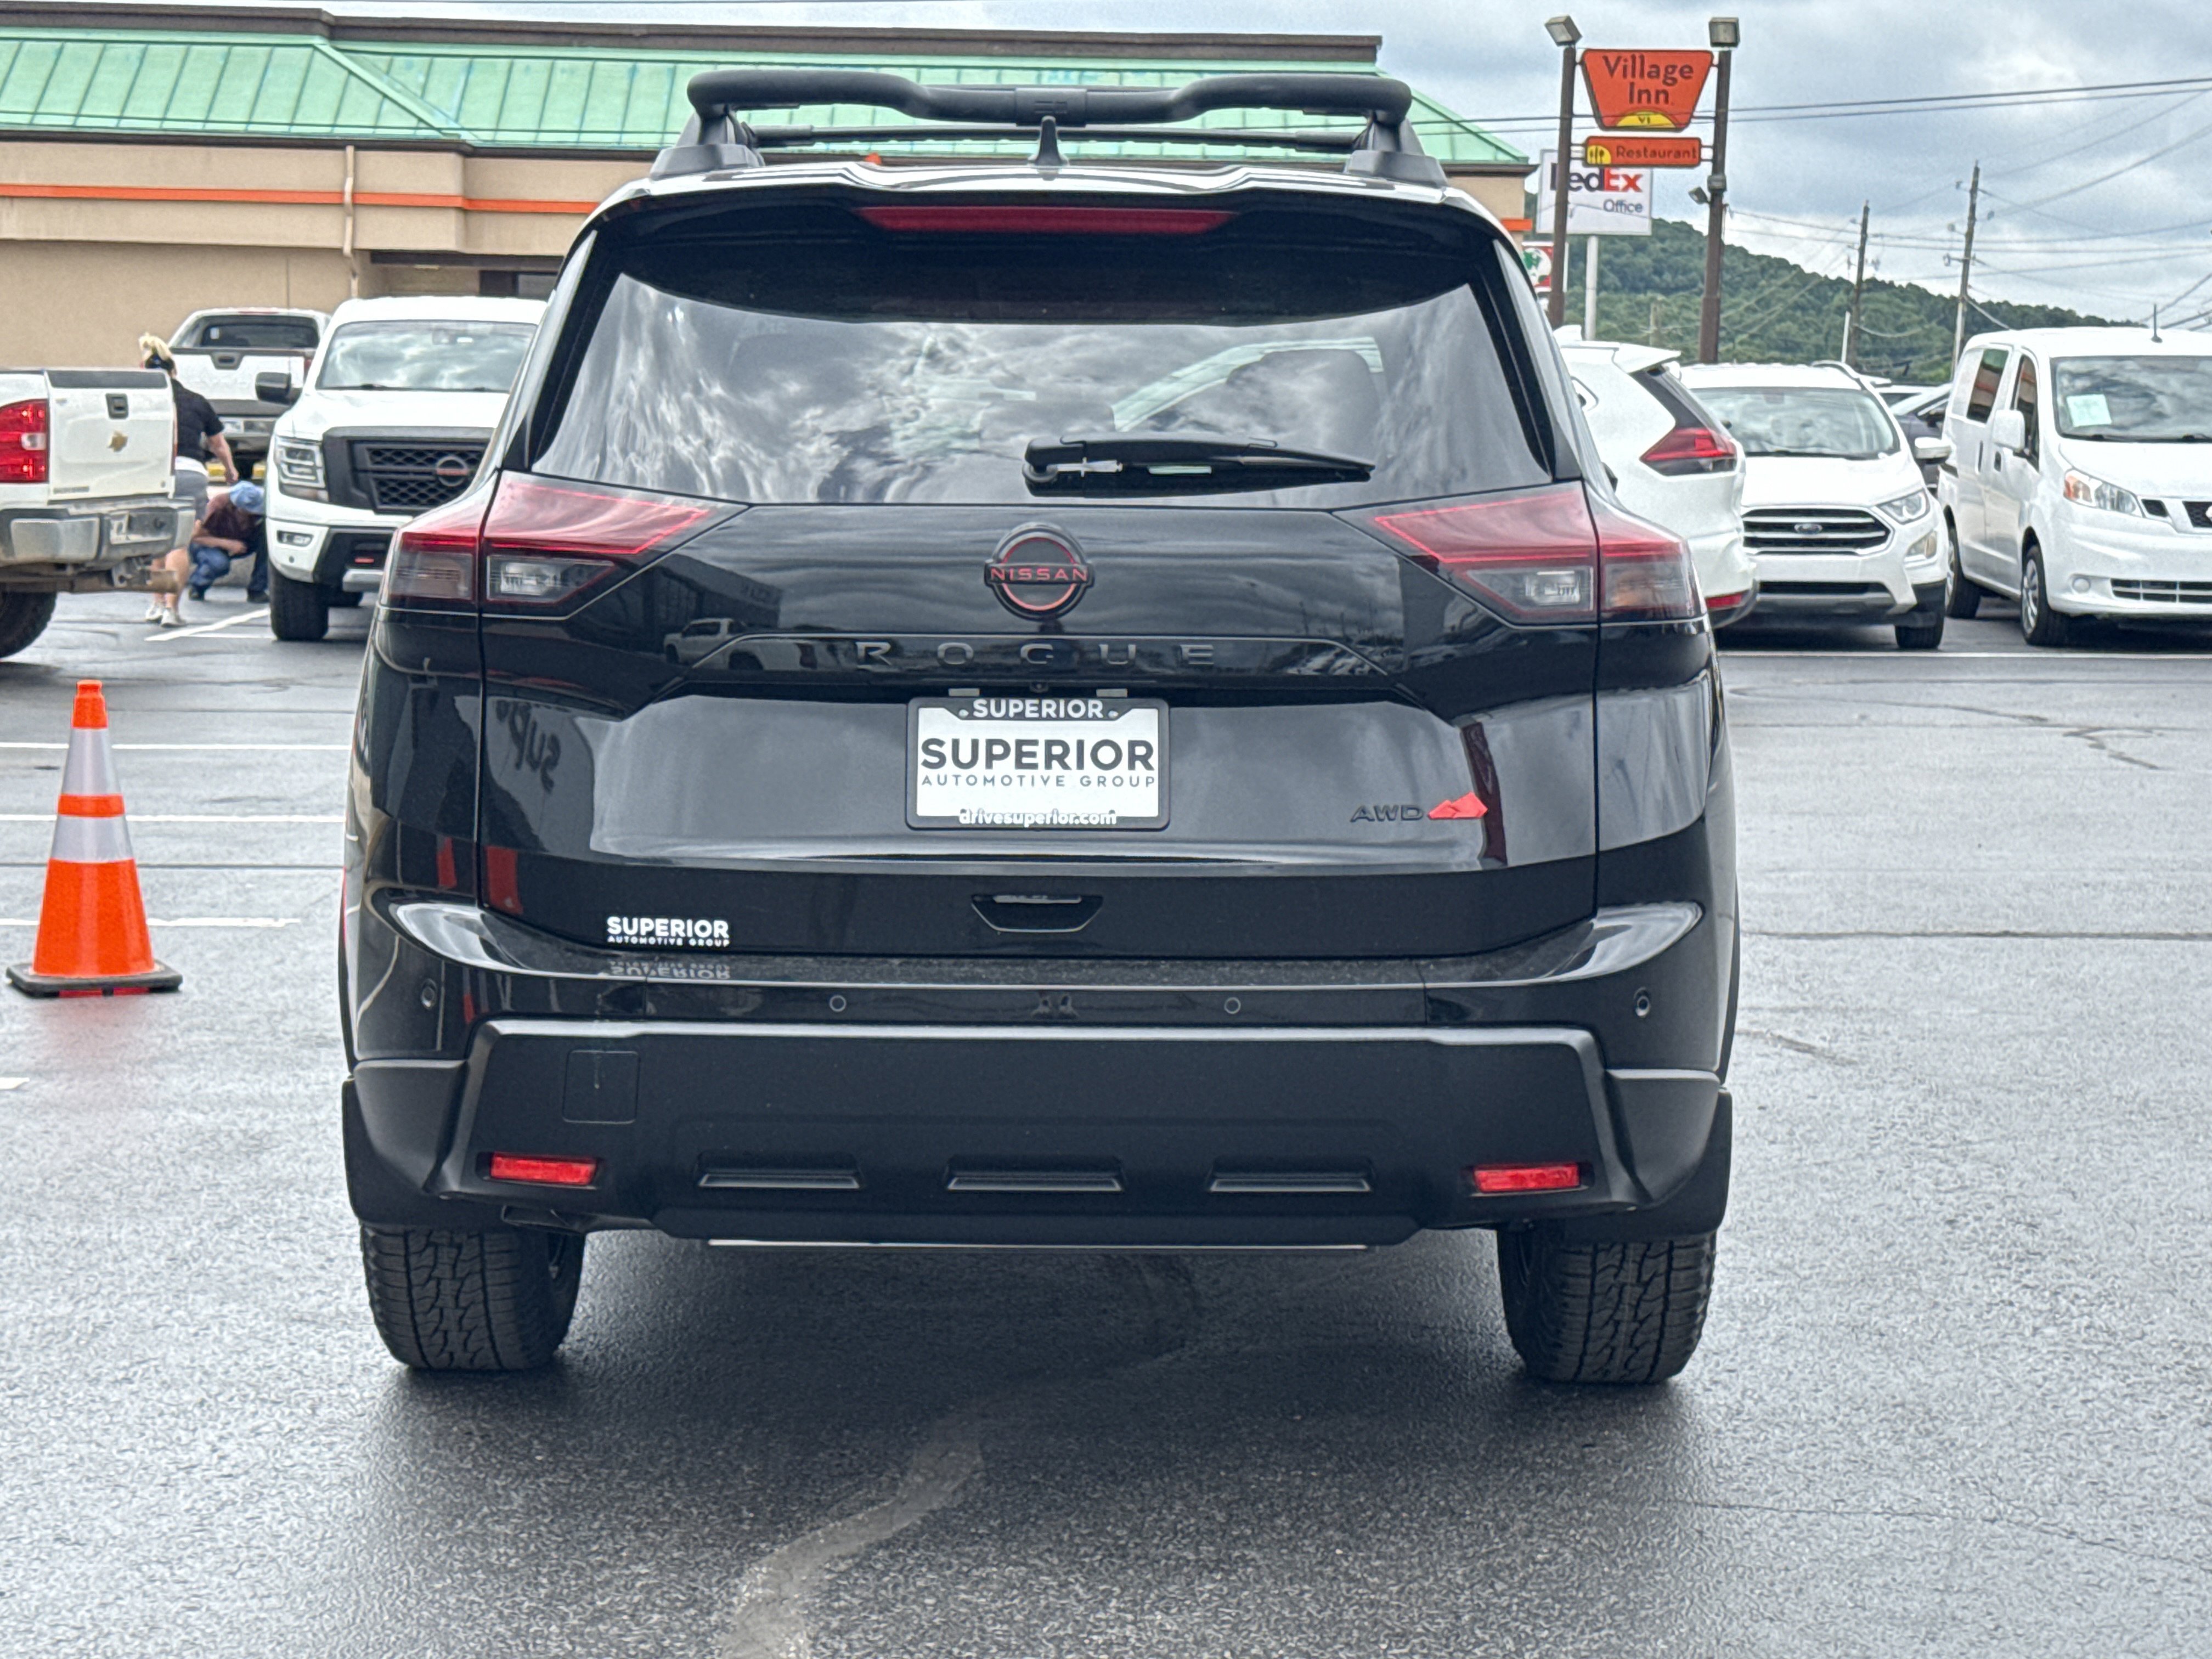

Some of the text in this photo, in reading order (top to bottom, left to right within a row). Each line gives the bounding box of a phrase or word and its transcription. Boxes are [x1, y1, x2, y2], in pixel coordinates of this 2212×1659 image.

[1602, 54, 1694, 86] Village
[1628, 82, 1669, 105] Inn
[1616, 145, 1697, 159] Restaurant
[1603, 199, 1643, 213] Office
[990, 567, 1088, 582] NISSAN
[855, 641, 1215, 665] ROGUE
[973, 698, 1104, 719] SUPERIOR
[921, 737, 1155, 771] SUPERIOR
[922, 774, 1155, 788] AUTOMOTIVE GROUP
[958, 808, 1118, 828] drivesuperior.com
[1350, 804, 1424, 822] AWD
[607, 916, 730, 938] SUPERIOR
[607, 935, 730, 947] AUTOMOTIVE GROUP
